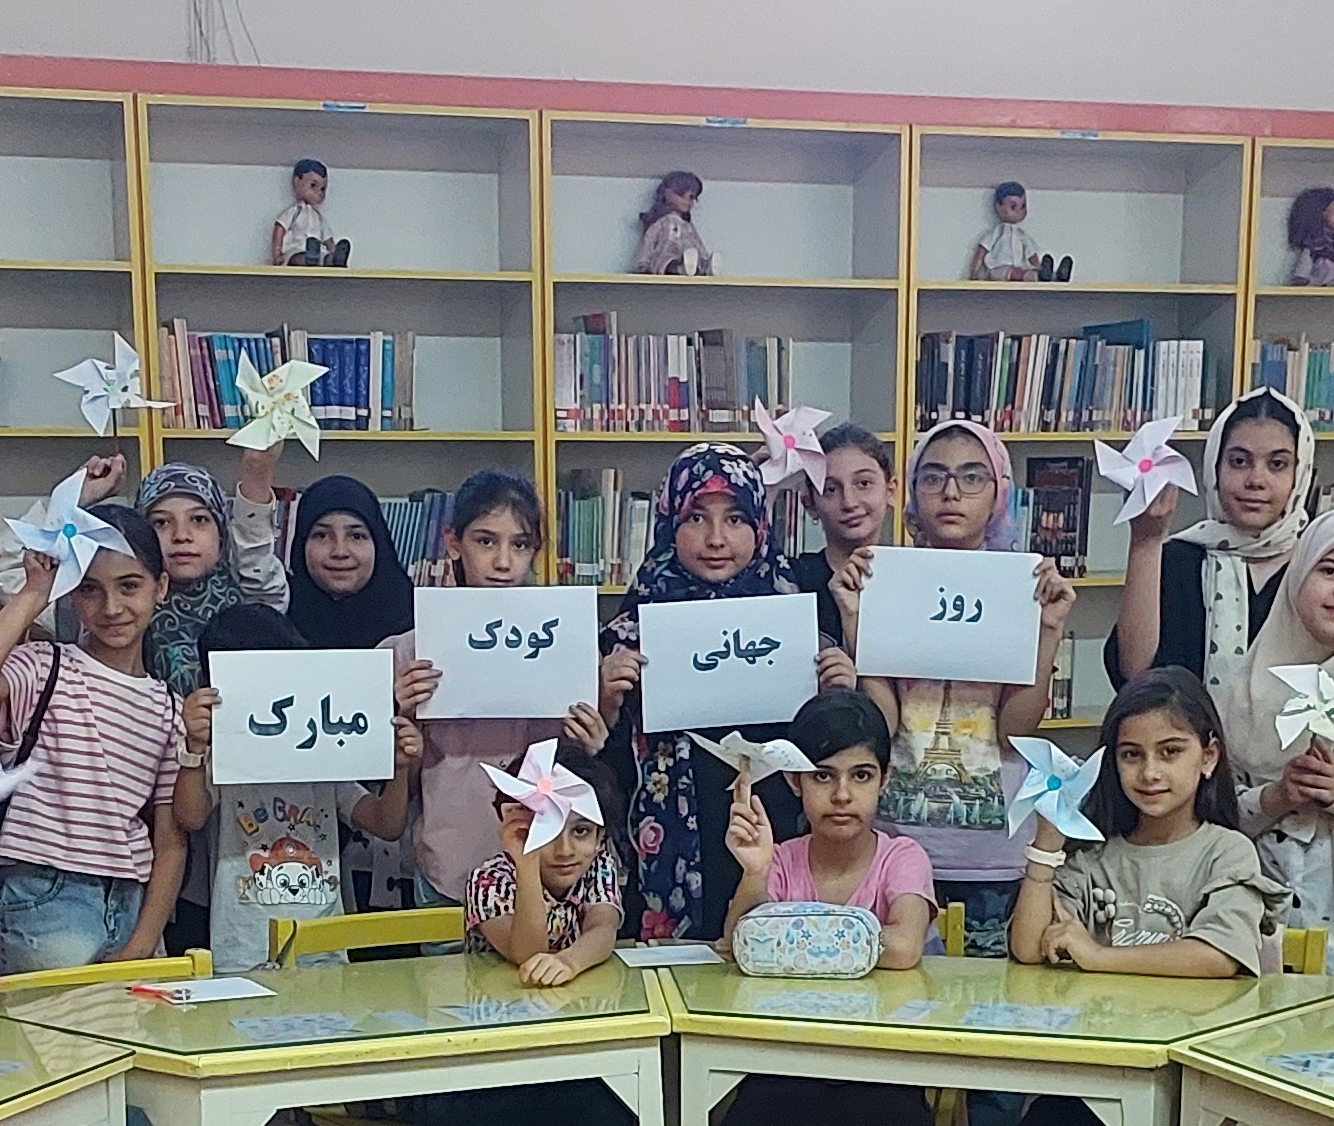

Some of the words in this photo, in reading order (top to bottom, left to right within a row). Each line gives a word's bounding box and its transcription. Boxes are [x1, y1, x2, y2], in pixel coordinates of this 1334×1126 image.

[929, 586, 983, 623] روز
[468, 617, 560, 660] کودک
[692, 628, 782, 672] جهانی
[248, 694, 369, 750] مبارک
